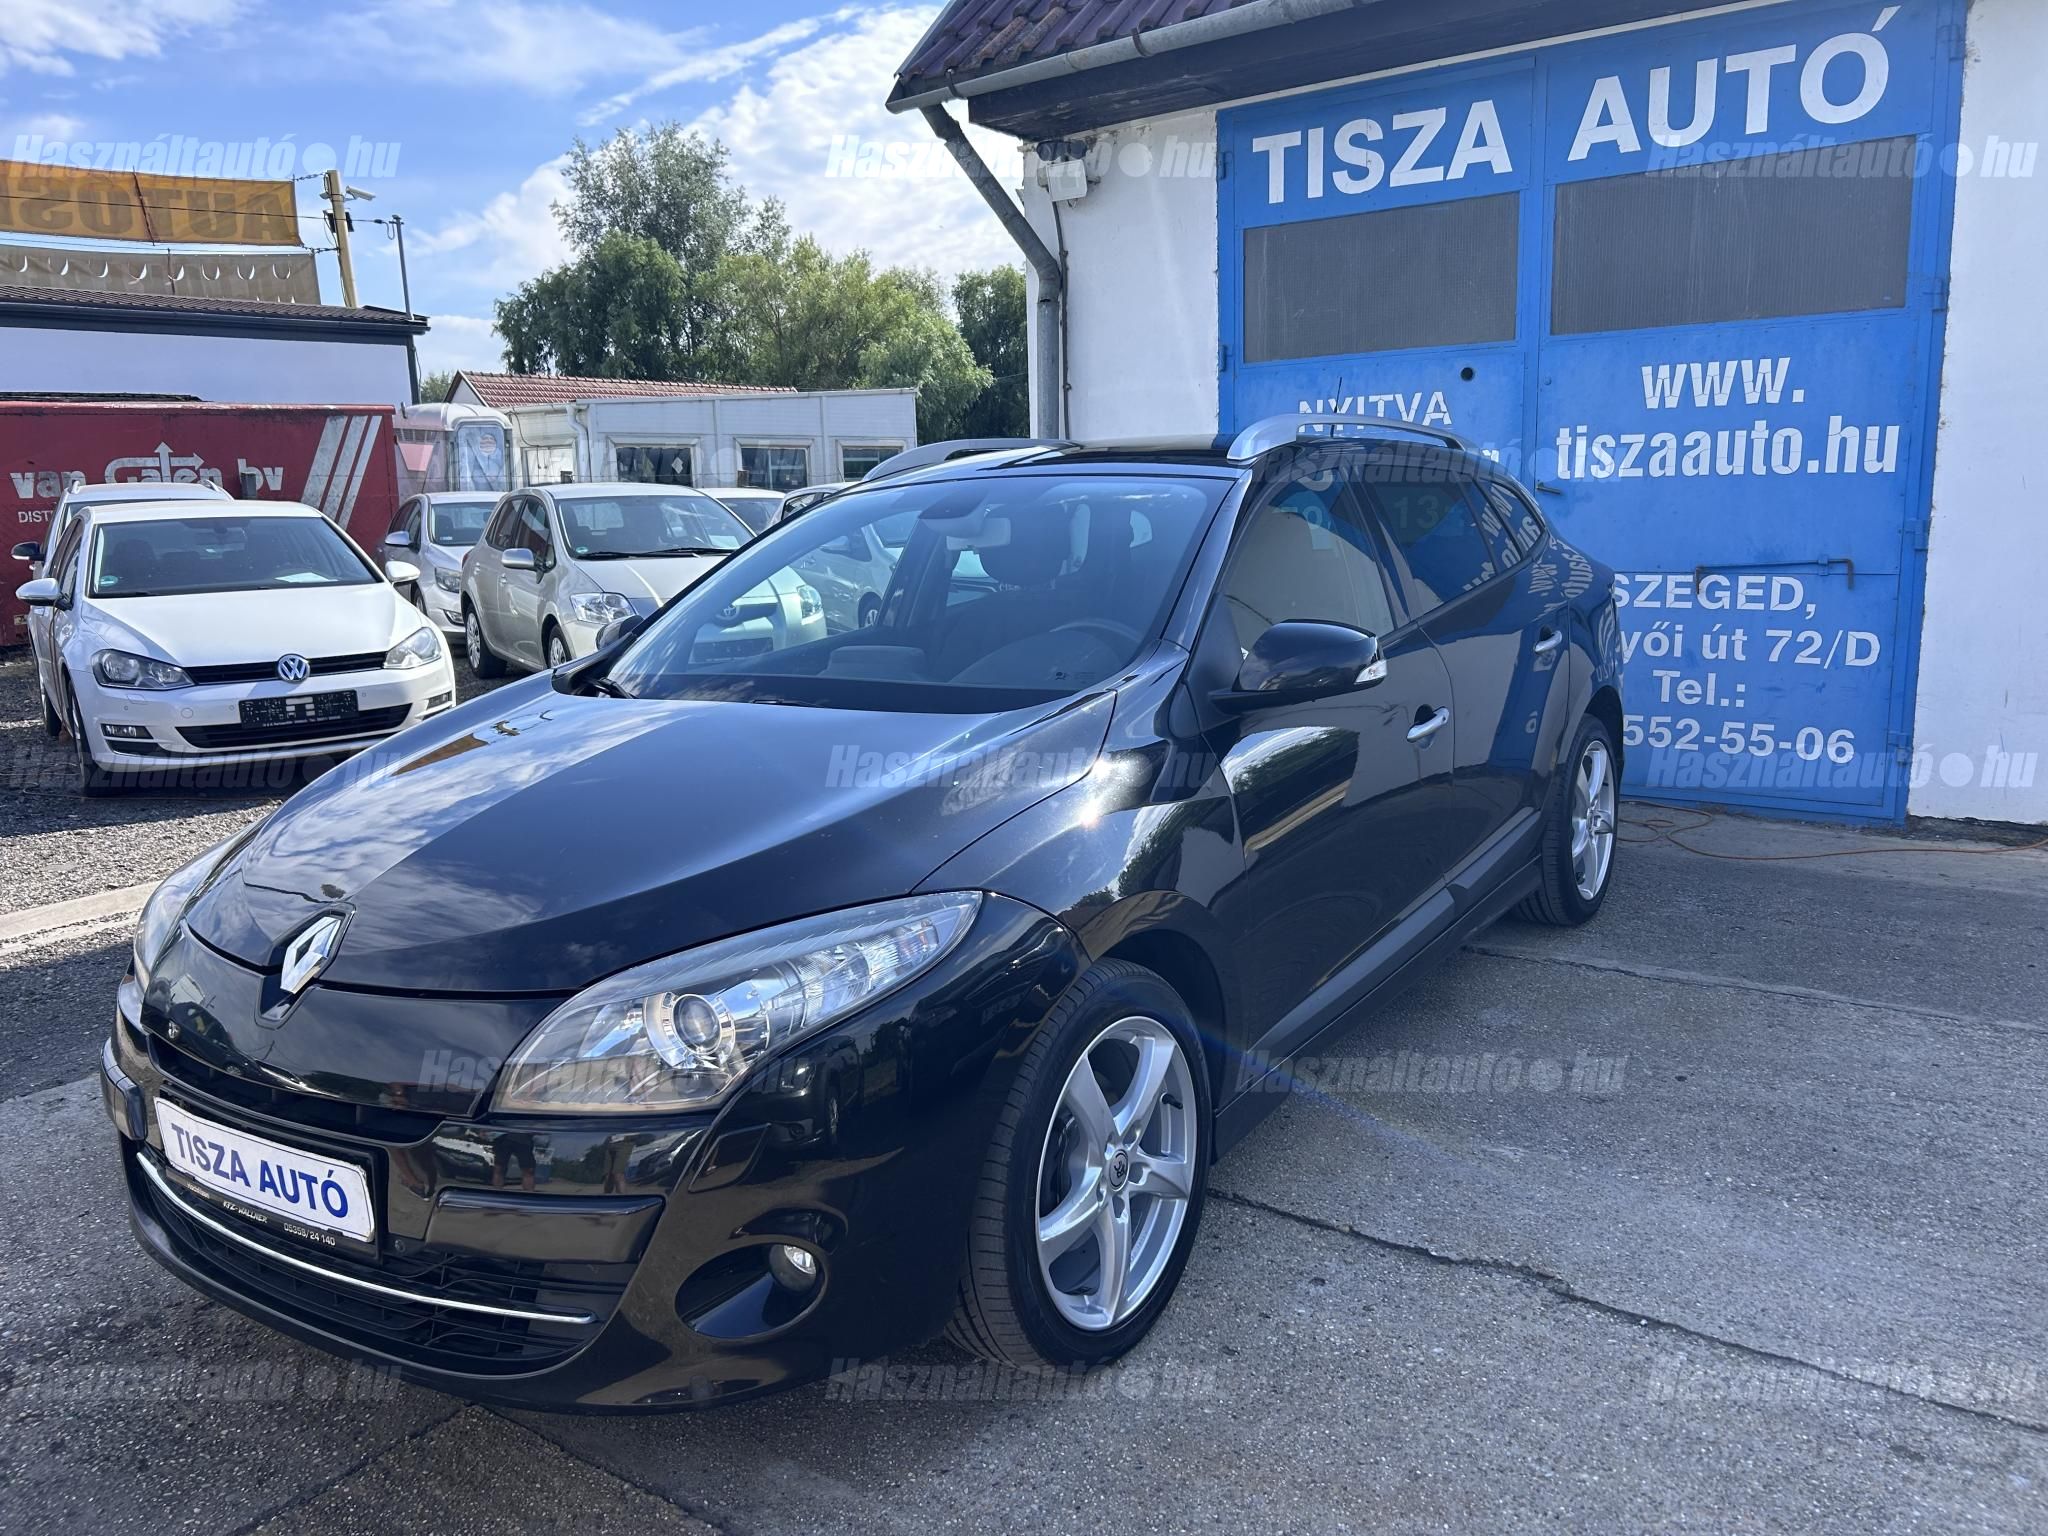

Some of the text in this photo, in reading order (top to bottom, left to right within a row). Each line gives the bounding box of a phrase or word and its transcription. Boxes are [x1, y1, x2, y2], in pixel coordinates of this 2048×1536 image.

[1253, 5, 1901, 204] TISZA AUTÓ
[1642, 356, 1805, 409] www.
[1556, 414, 1900, 479] tiszaauto.hu
[18, 510, 54, 523] DIST
[1614, 573, 1817, 620] SZEGED,
[1701, 623, 1748, 661] út
[1764, 629, 1881, 669] 72/D
[1652, 669, 1746, 708] Tel.:
[1622, 714, 1856, 764] 552-55-06
[171, 1122, 349, 1219] TISZA AUTÓ
